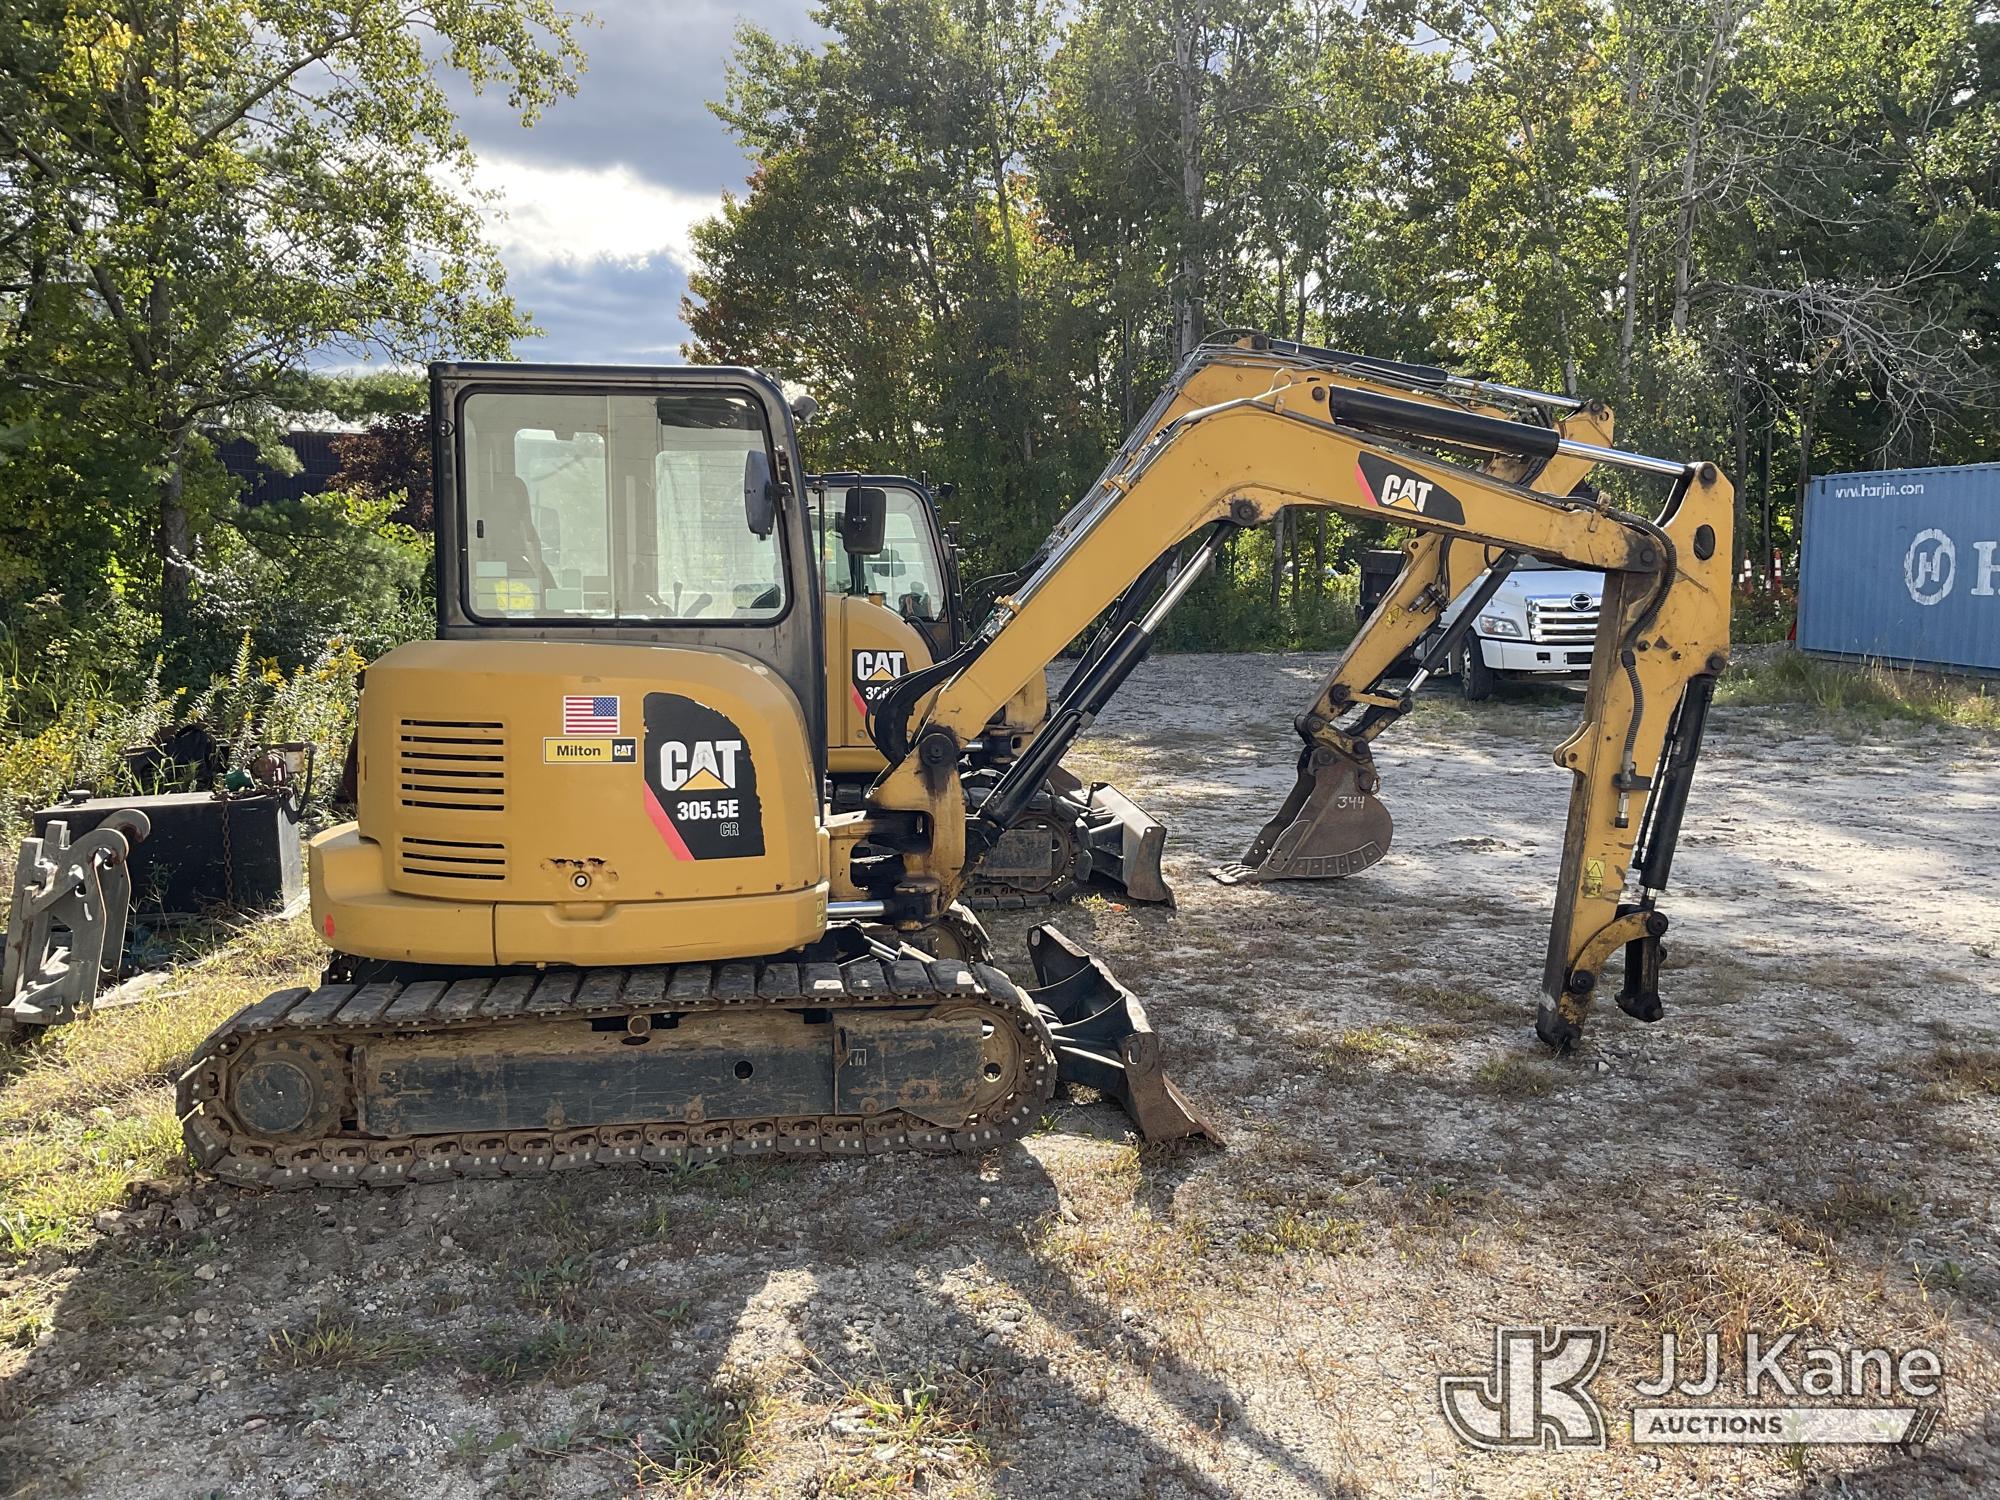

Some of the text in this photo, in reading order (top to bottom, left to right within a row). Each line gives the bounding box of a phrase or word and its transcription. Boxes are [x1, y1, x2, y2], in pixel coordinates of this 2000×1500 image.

[1381, 474, 1433, 513] CAT
[857, 651, 905, 681] CAT
[556, 744, 634, 757] Milton CAT
[660, 740, 742, 792] CAT
[677, 799, 739, 821] 305.5E
[1337, 796, 1365, 810] 344
[719, 821, 740, 837] CR
